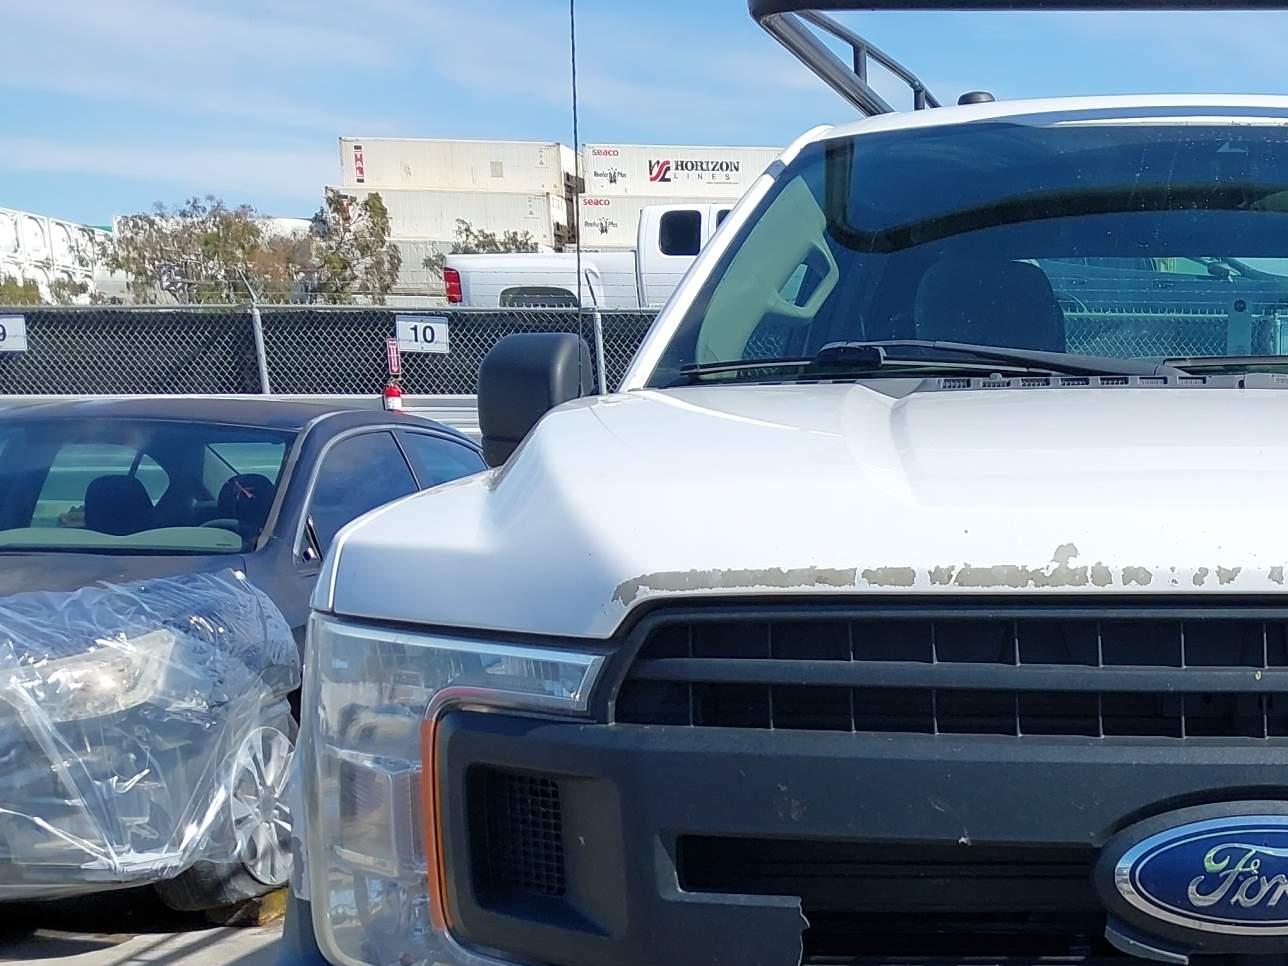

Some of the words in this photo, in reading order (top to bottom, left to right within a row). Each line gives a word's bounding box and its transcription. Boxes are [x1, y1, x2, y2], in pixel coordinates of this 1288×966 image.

[673, 160, 740, 172] HORIZON
[673, 172, 730, 181] LINES
[583, 198, 610, 206] seaco
[410, 324, 435, 344] 10
